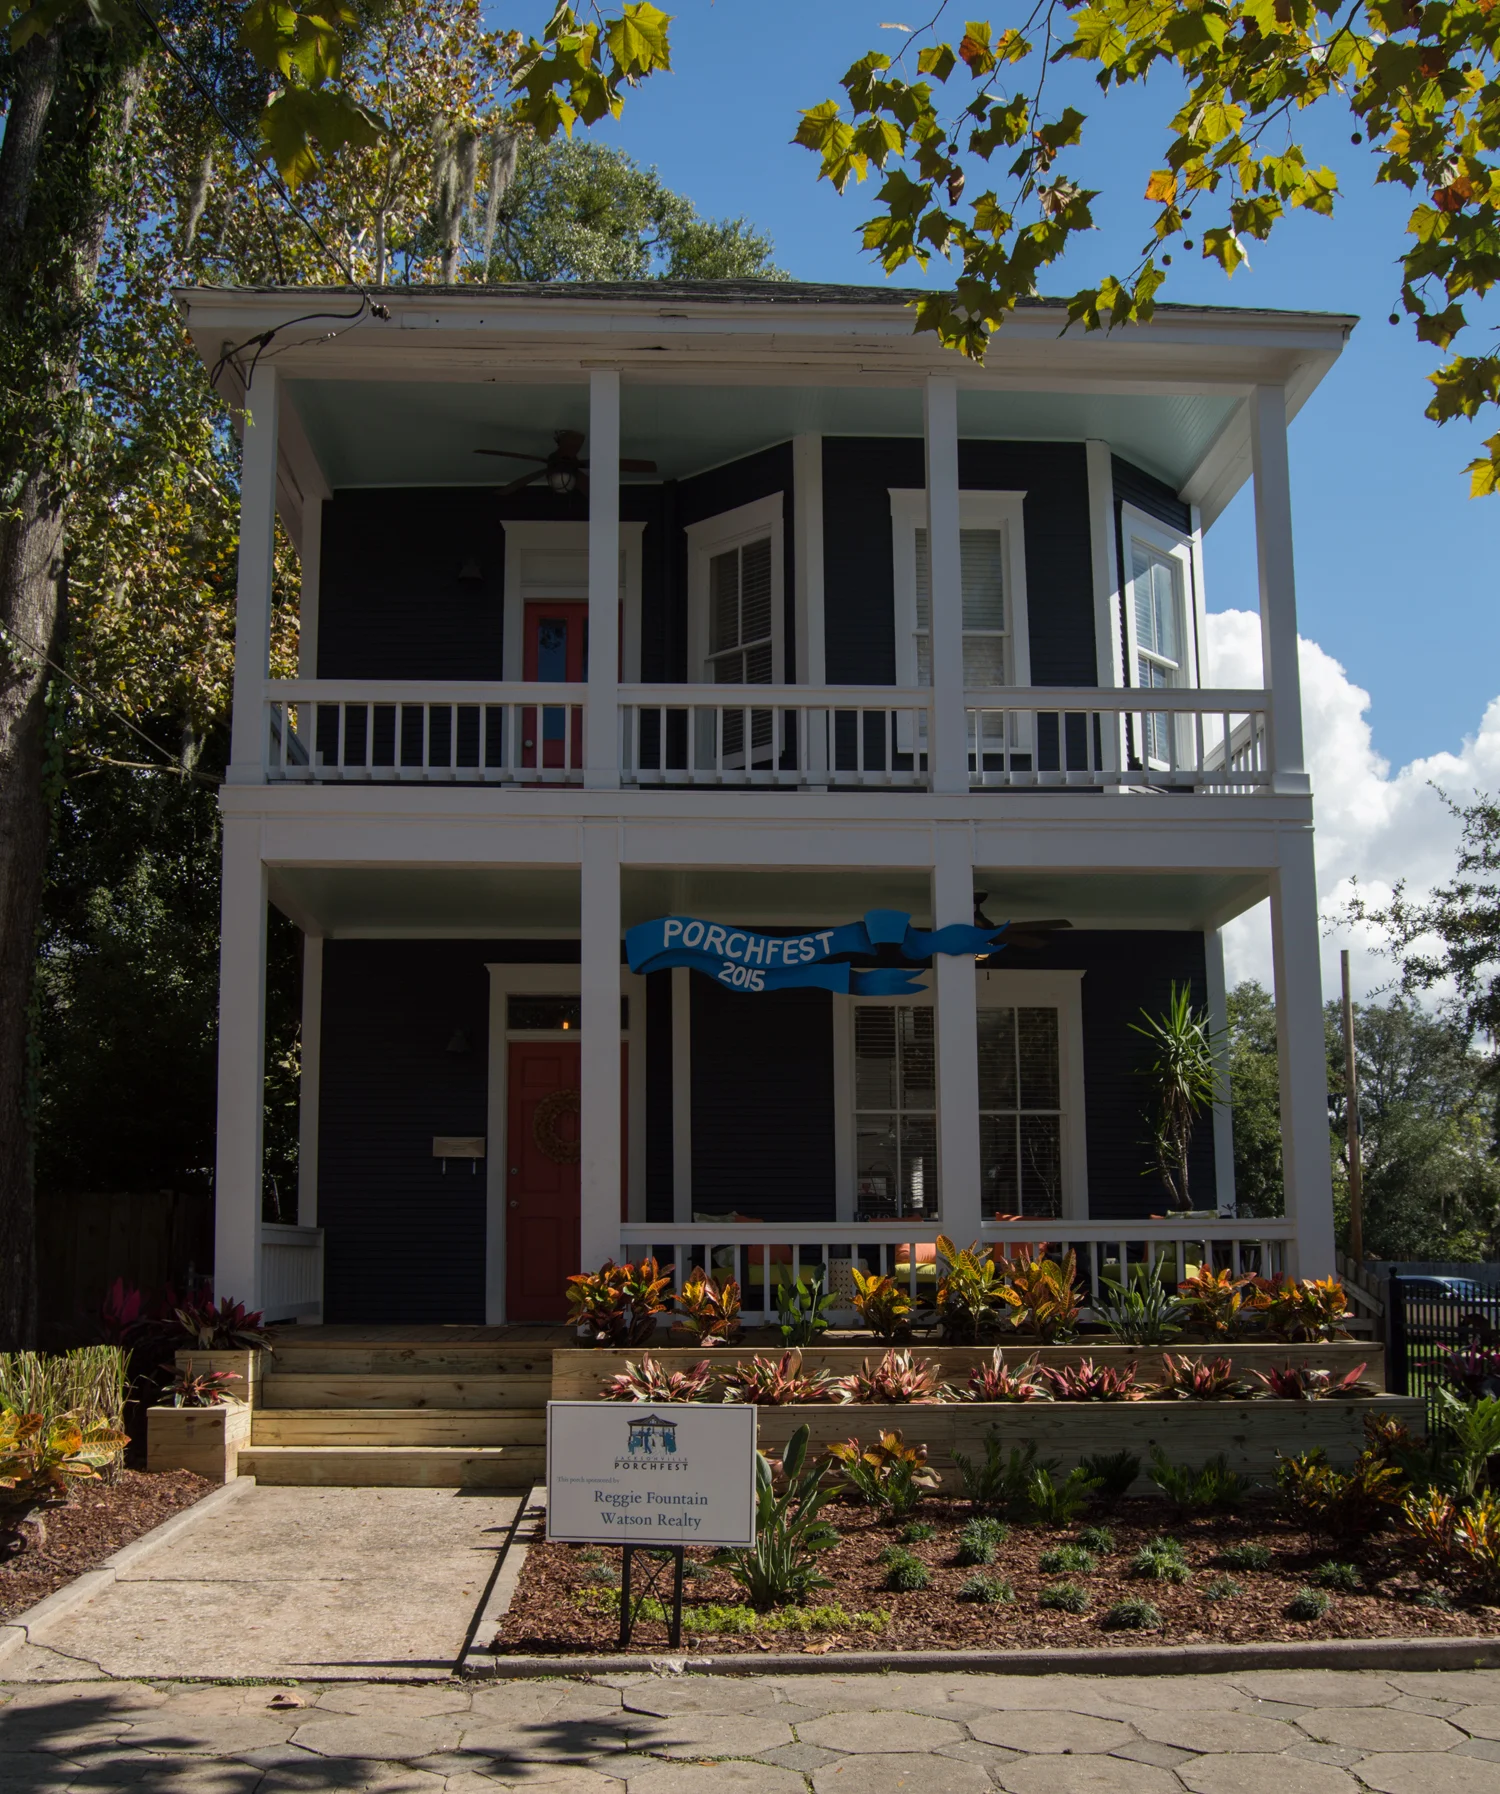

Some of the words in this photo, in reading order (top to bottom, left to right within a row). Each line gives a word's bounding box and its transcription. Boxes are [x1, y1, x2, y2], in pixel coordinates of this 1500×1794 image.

[663, 919, 834, 965] PORCHFEST
[717, 961, 766, 992] 2015
[614, 1462, 689, 1471] PORCHFEST
[569, 1476, 585, 1484] porch
[586, 1477, 611, 1485] sponsored
[594, 1490, 642, 1507] Reggie
[646, 1492, 708, 1506] Fountain
[601, 1512, 652, 1526] Watson
[657, 1513, 702, 1530] Realty
